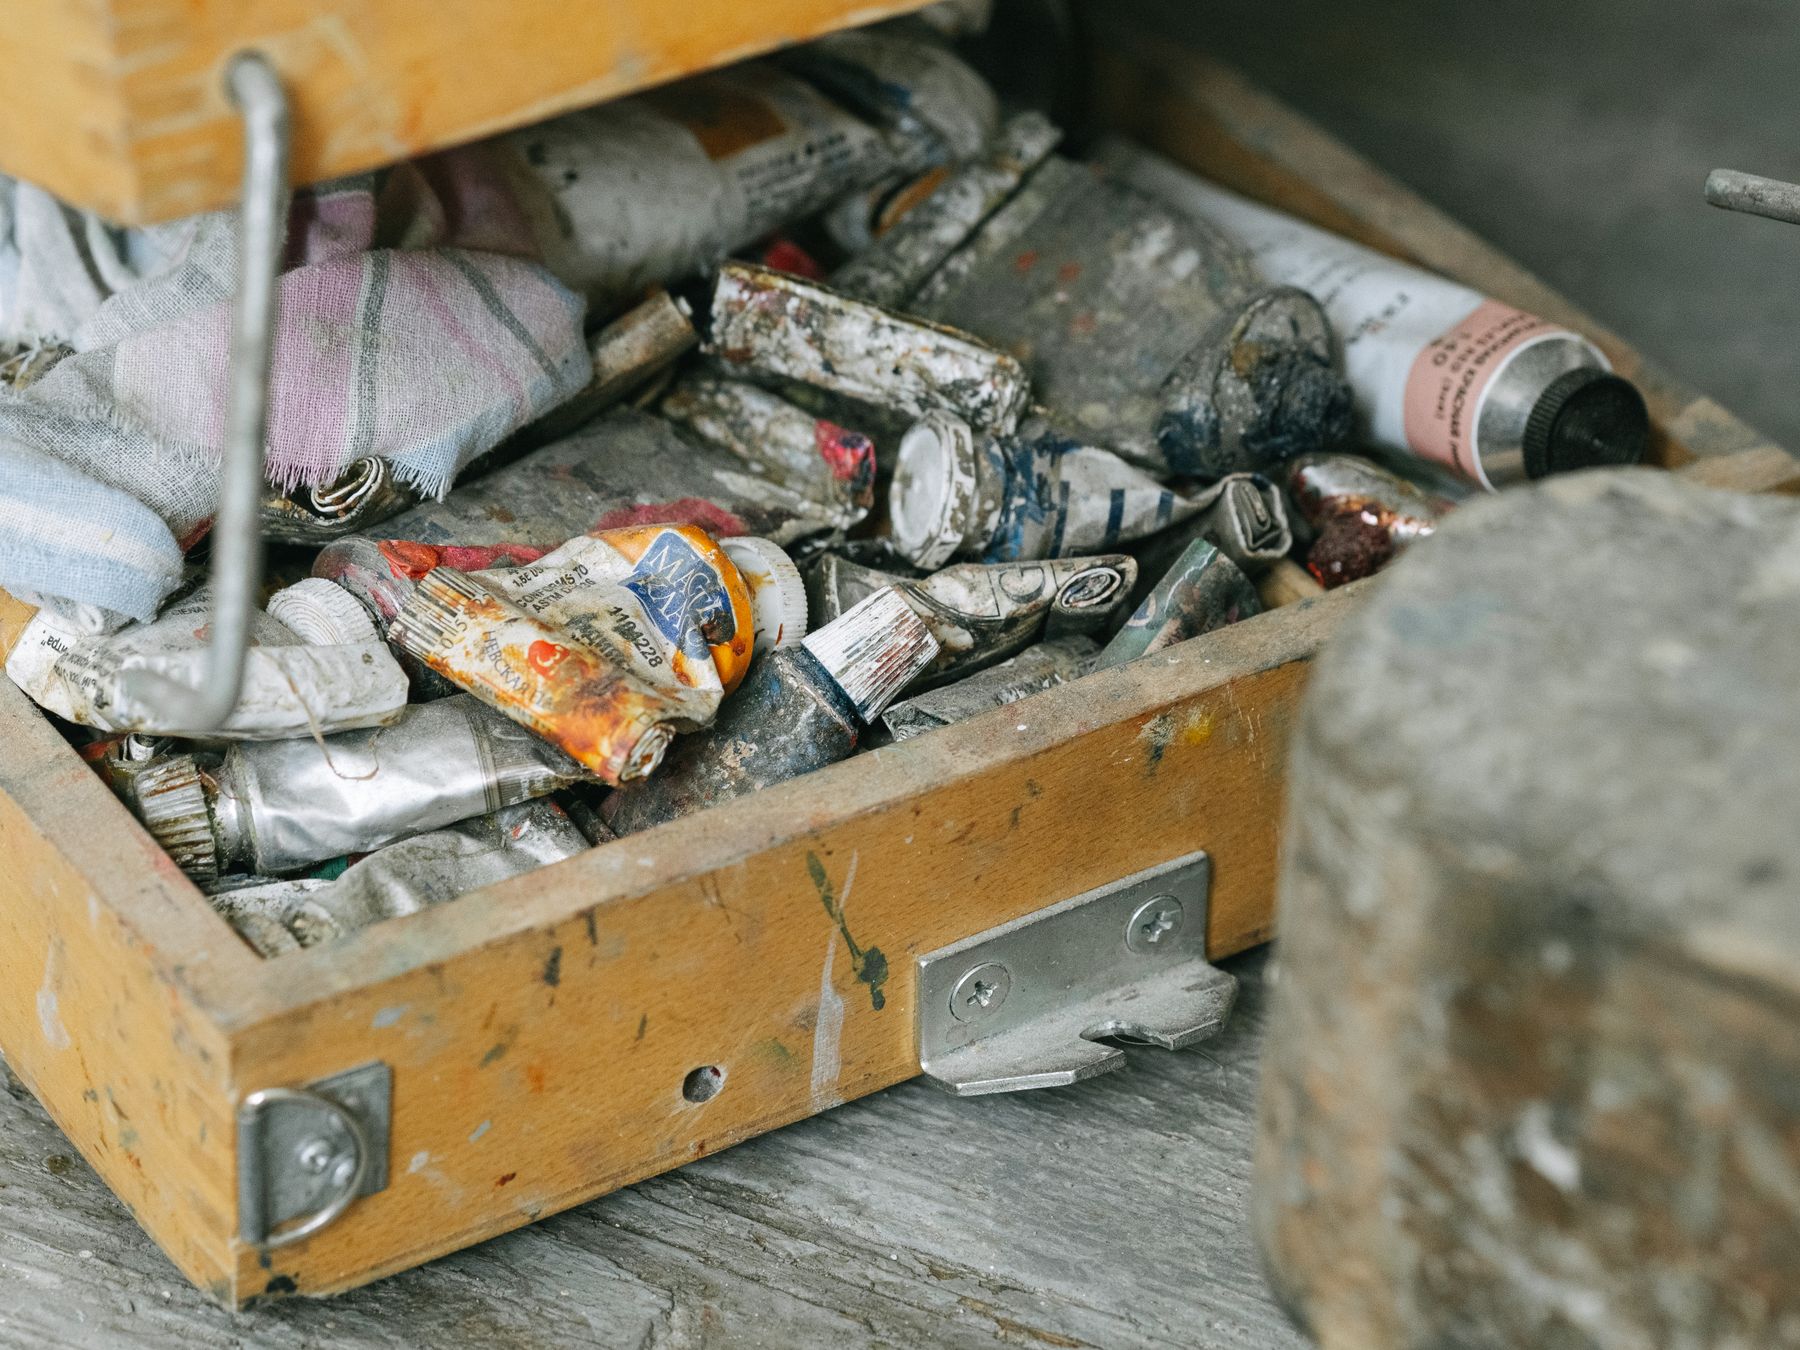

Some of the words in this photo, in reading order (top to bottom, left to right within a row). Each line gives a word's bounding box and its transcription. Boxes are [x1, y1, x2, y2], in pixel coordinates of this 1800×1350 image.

[516, 573, 575, 609] CONFORMS
[572, 563, 589, 579] TO
[532, 591, 565, 614] ASTM
